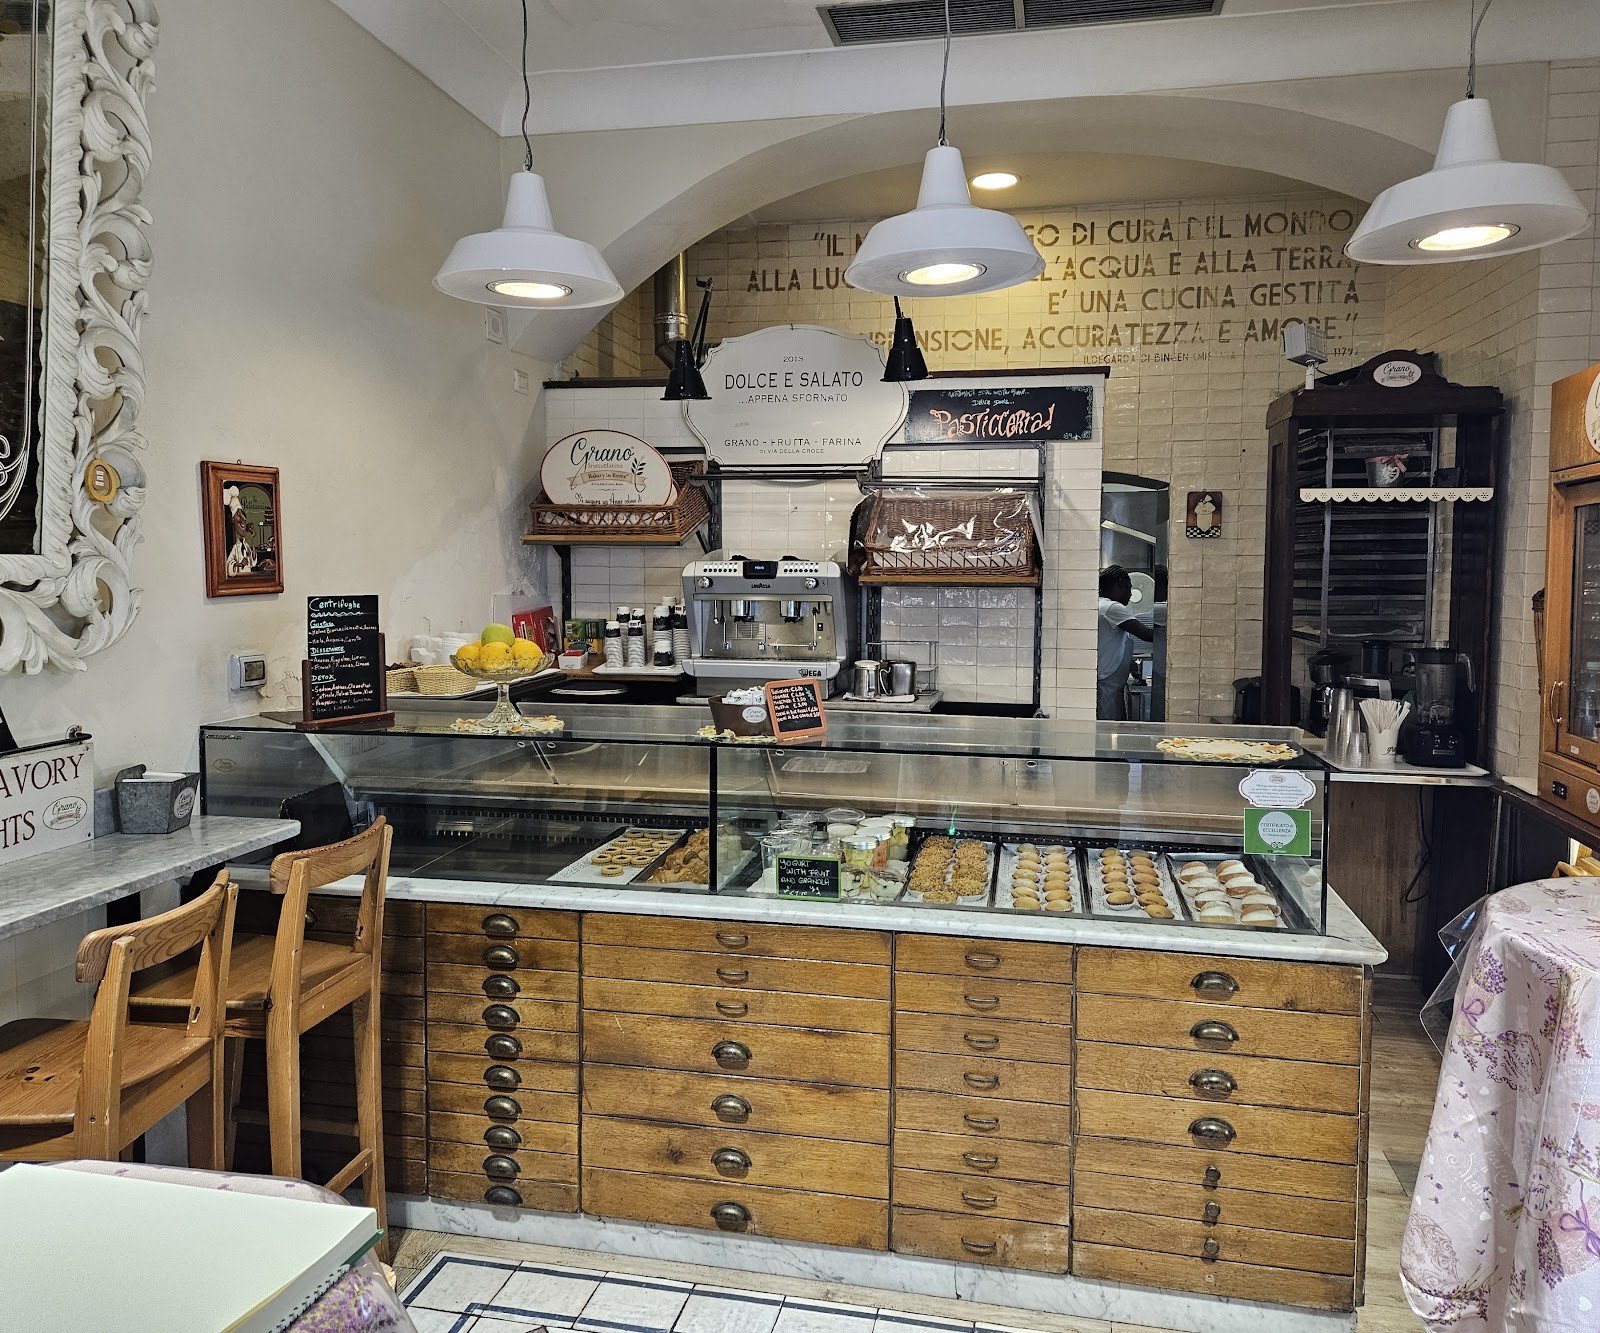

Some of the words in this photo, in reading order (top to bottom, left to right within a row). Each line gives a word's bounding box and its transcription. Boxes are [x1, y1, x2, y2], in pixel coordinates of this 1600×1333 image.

[1072, 221, 1095, 246] DI
[1107, 217, 1174, 243] CURA
[1244, 209, 1354, 238] MONDO
[746, 268, 801, 292] ALLA
[1169, 252, 1182, 276] E
[1194, 249, 1257, 275] ALLA
[1048, 289, 1067, 315] E'
[1080, 289, 1128, 314] UNA
[1141, 284, 1237, 311] CUCINA
[1249, 279, 1360, 307] GESTITA
[1219, 319, 1232, 343] E
[783, 355, 804, 363] 2013
[1140, 352, 1152, 364] DI
[725, 373, 778, 389] DOLCE
[784, 372, 794, 388] E
[799, 371, 864, 388] SALATO
[792, 393, 848, 402] SFORNATO
[724, 438, 759, 447] GRANO
[771, 437, 811, 446] FRUTTA
[822, 437, 862, 446] FARINA
[570, 437, 635, 476] Grano
[309, 598, 361, 611] Centrifughe
[311, 674, 335, 682] DETOX
[799, 668, 821, 677] WEGA
[52, 801, 79, 815] Grano
[780, 859, 812, 870] YOGURT
[786, 868, 807, 876] WITH
[808, 869, 831, 878] FRUIT
[798, 877, 830, 886] GRANOLA
